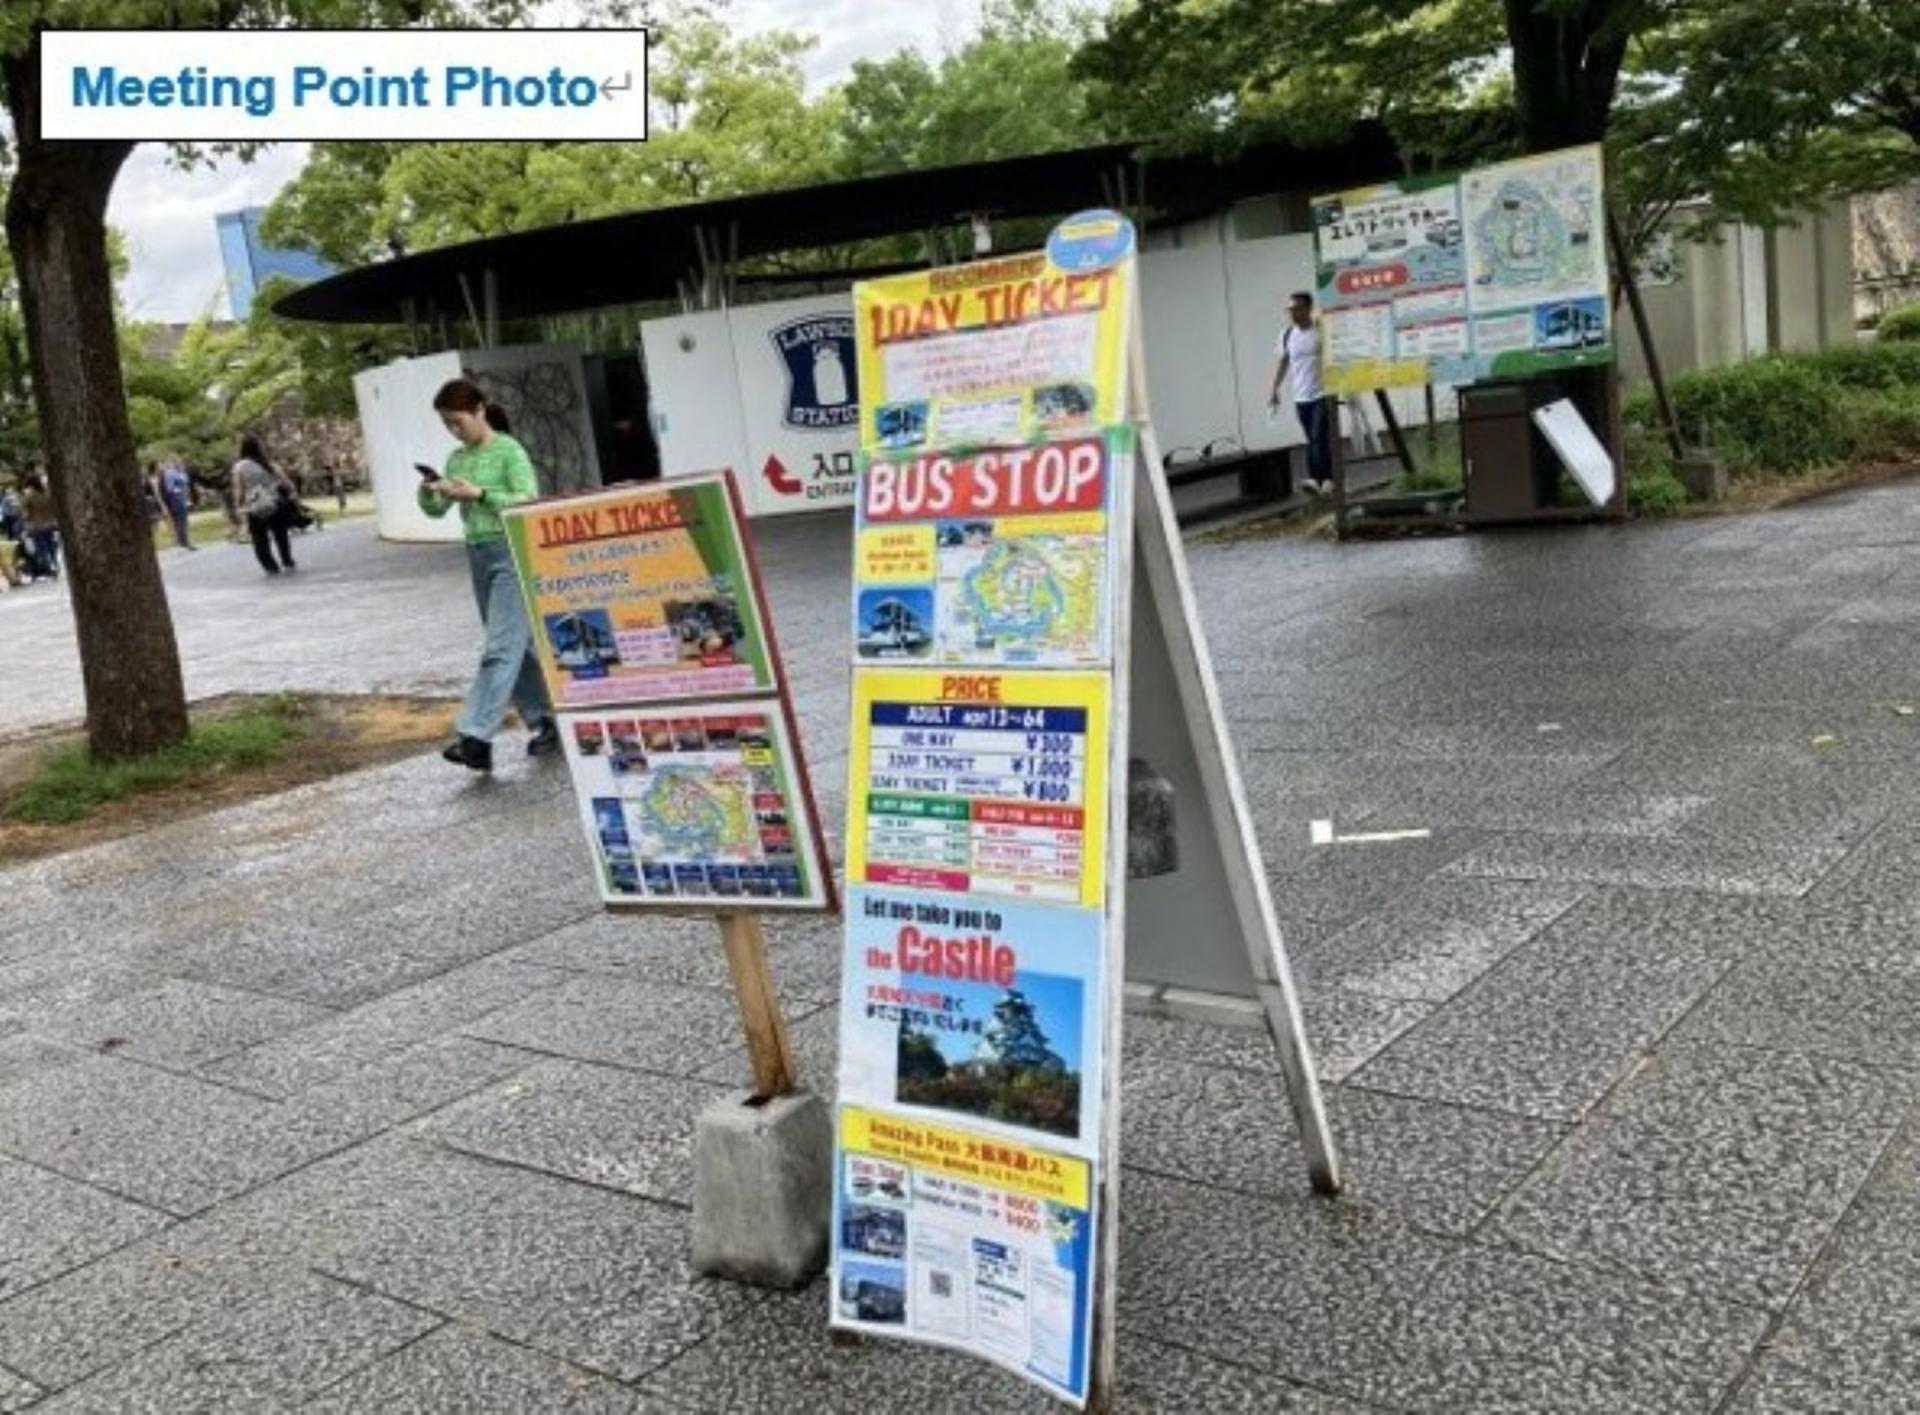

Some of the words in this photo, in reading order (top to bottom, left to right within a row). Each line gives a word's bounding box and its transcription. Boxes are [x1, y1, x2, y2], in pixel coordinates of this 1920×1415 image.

[870, 295, 961, 347] 1DAY
[978, 269, 1117, 327] TICKET
[780, 321, 856, 350] LAWSO
[792, 404, 859, 425] STATIO
[813, 452, 853, 479] 入口
[867, 457, 953, 515] BUS
[972, 446, 1100, 507] STOP
[539, 509, 598, 544] 1DAY
[942, 677, 1002, 699] PRICE
[906, 705, 953, 724] ADULT
[925, 754, 975, 771] TICKET
[864, 897, 885, 917] Let
[891, 902, 914, 920] me
[916, 902, 950, 924] take
[954, 909, 982, 929] you
[984, 909, 1002, 931] to
[867, 947, 891, 969] the
[898, 925, 1015, 987] Castle
[926, 1127, 959, 1152] Pass
